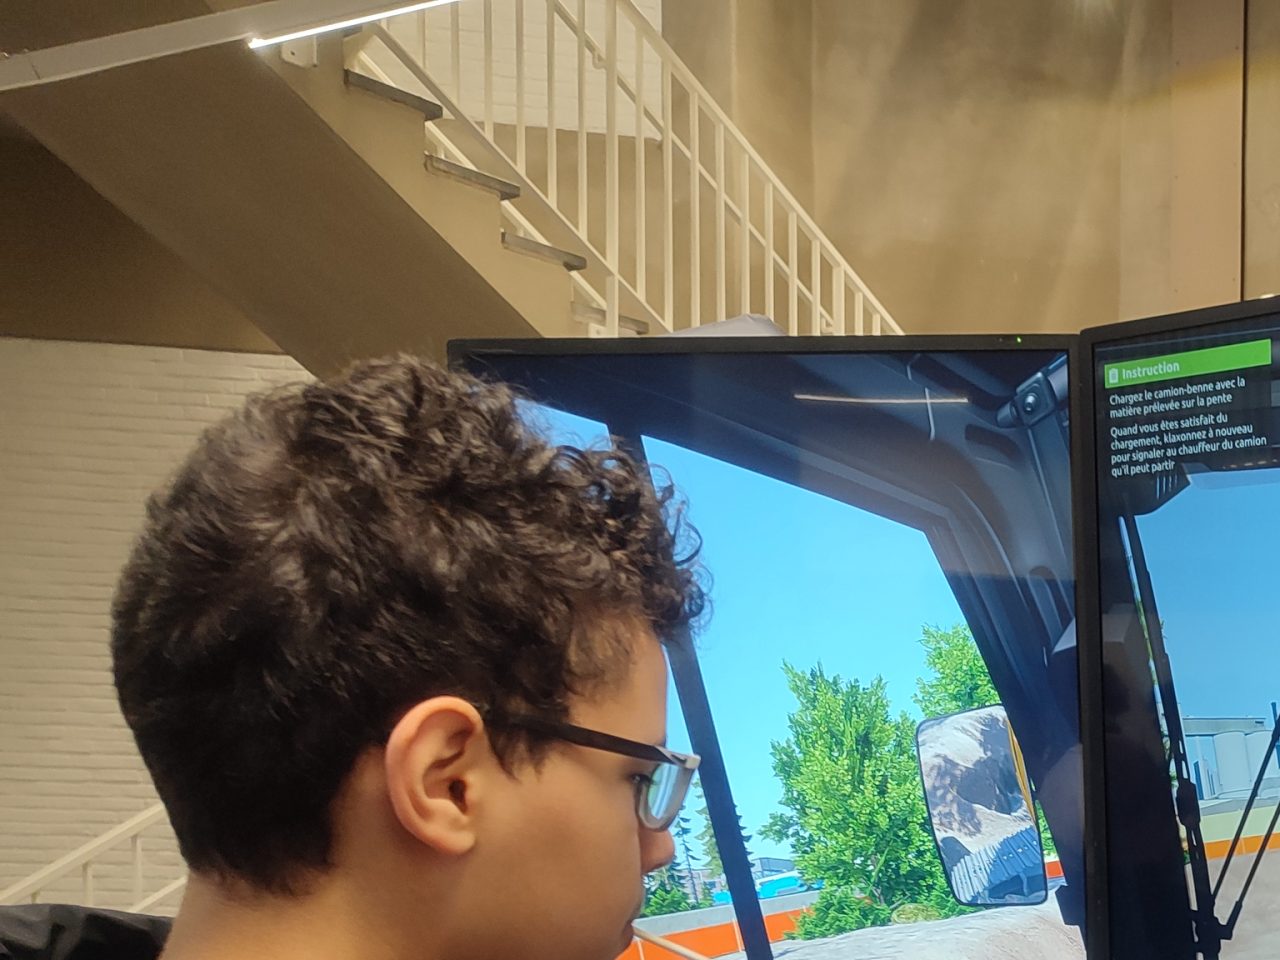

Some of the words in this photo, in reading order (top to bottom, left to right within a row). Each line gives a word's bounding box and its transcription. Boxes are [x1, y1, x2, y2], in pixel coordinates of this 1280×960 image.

[1122, 361, 1180, 380] Instruction
[1109, 393, 1143, 406] Chargez
[1144, 389, 1153, 401] le
[1154, 382, 1214, 400] camion-benne
[1215, 379, 1236, 391] avec
[1236, 375, 1246, 387] la
[1110, 406, 1142, 419] matière
[1143, 400, 1181, 416] prélevée
[1181, 399, 1196, 409] sur
[1196, 395, 1205, 407] la
[1206, 393, 1233, 407] pente
[1110, 423, 1138, 439] Quand
[1139, 423, 1159, 434] vous
[1160, 419, 1179, 431] êtes
[1180, 414, 1215, 428] satisfait
[1216, 411, 1229, 424] du
[1110, 434, 1163, 451] chargement,
[1163, 429, 1207, 444] klaxonnez
[1208, 426, 1214, 438] à
[1215, 424, 1253, 437] nouveau
[1111, 453, 1131, 466] pour
[1131, 447, 1165, 462] signaler
[1166, 447, 1177, 457] au
[1178, 440, 1220, 456] chauffeur
[1221, 437, 1234, 451] du
[1234, 435, 1267, 449] camion
[1111, 463, 1129, 479] qu'il
[1130, 463, 1150, 477] peut
[1151, 458, 1176, 474] partir
